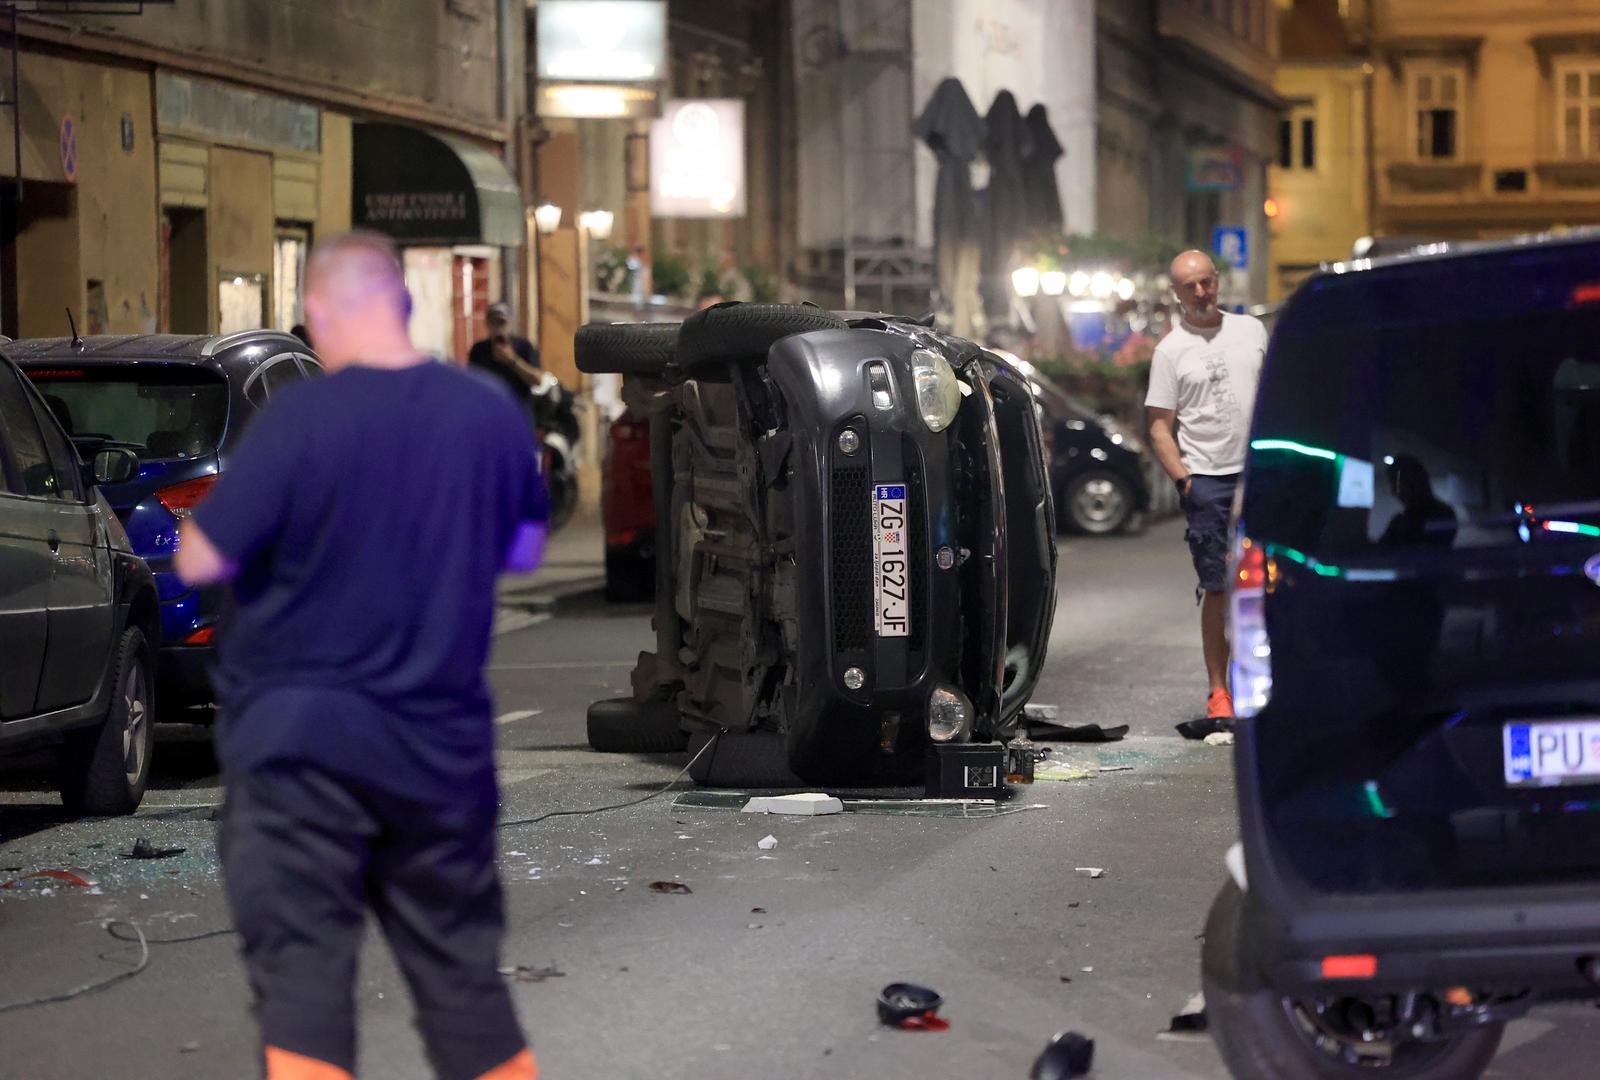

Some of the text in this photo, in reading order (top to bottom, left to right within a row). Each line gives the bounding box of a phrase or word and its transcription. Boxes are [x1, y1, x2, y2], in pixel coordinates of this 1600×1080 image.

[880, 487, 888, 499] HR
[881, 502, 904, 529] ZG
[1538, 731, 1584, 768] PU
